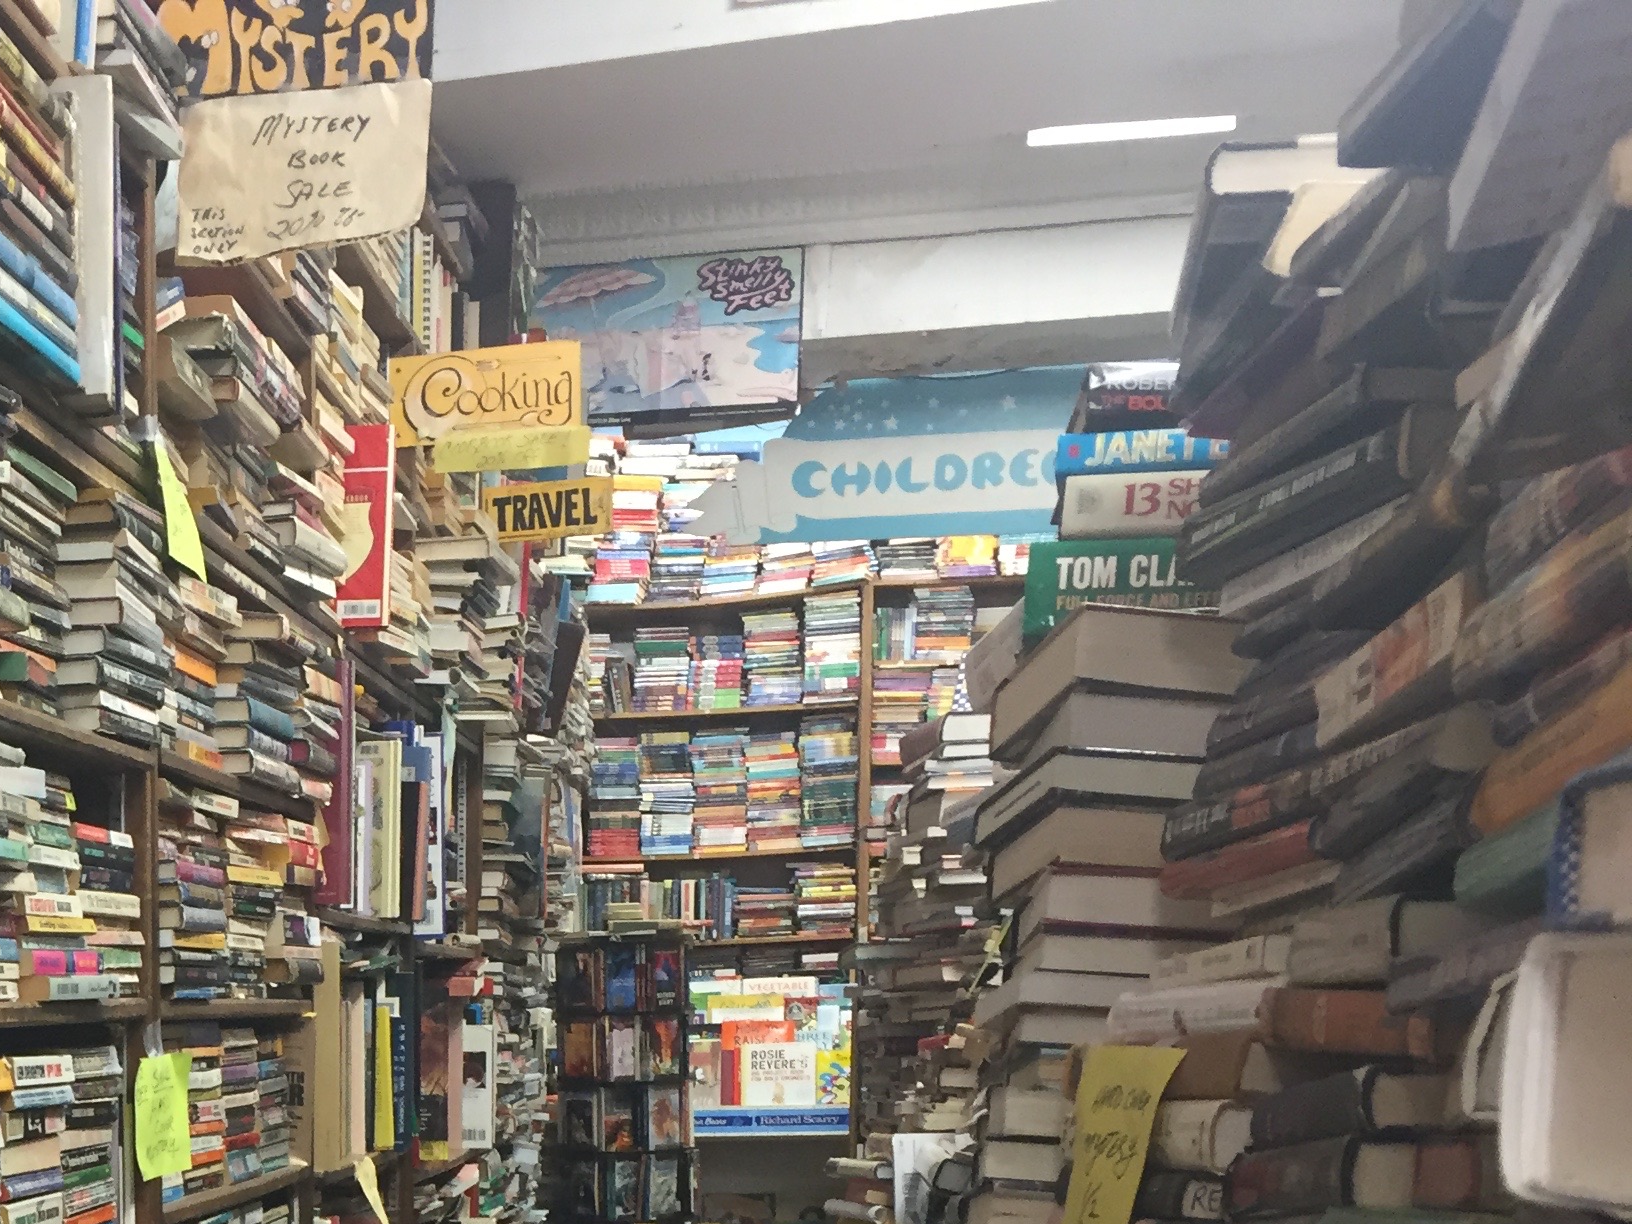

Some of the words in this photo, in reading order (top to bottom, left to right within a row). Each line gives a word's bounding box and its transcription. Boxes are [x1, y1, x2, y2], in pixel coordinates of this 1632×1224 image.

[156, 0, 430, 95] MYSTERY
[253, 113, 371, 146] MYSTERY
[288, 149, 346, 169] BOOK
[274, 180, 354, 209] SALE
[421, 367, 574, 426] Cooking
[492, 487, 599, 533] TRAVEL
[1124, 482, 1163, 517] 13
[1056, 555, 1118, 590] TOM
[751, 1049, 786, 1061] ROSIE
